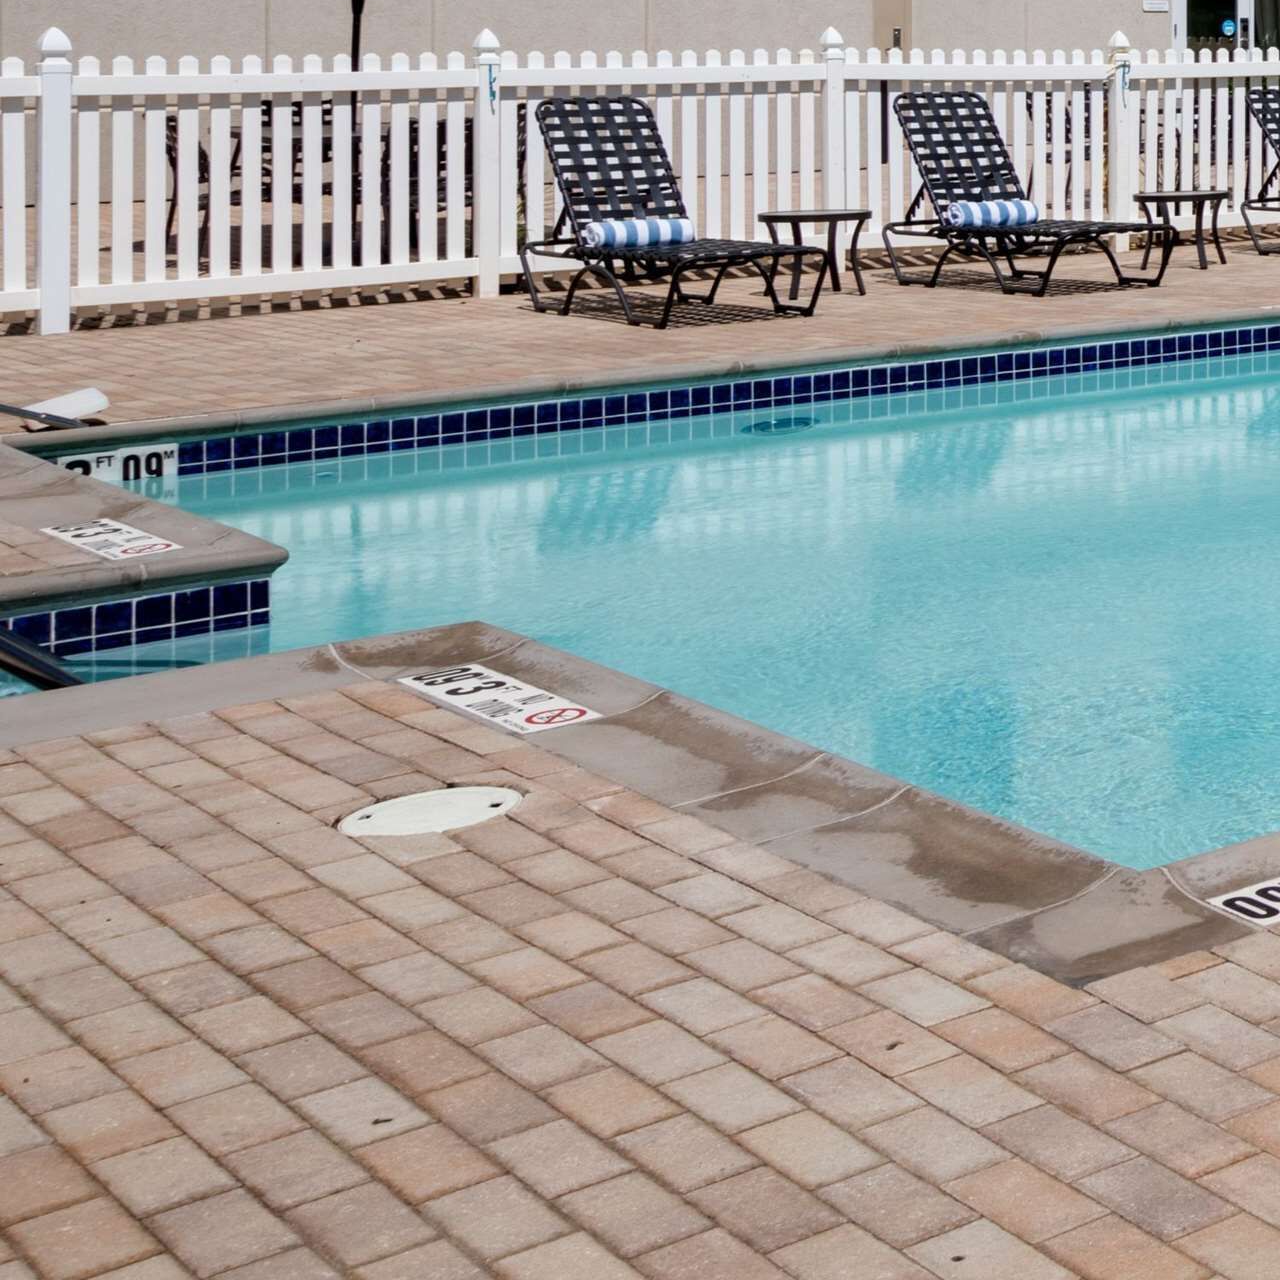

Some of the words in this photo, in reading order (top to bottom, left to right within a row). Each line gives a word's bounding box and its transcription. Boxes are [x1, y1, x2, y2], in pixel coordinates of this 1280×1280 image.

[96, 455, 115, 469] FT
[163, 449, 175, 460] M
[445, 680, 507, 696] 3
